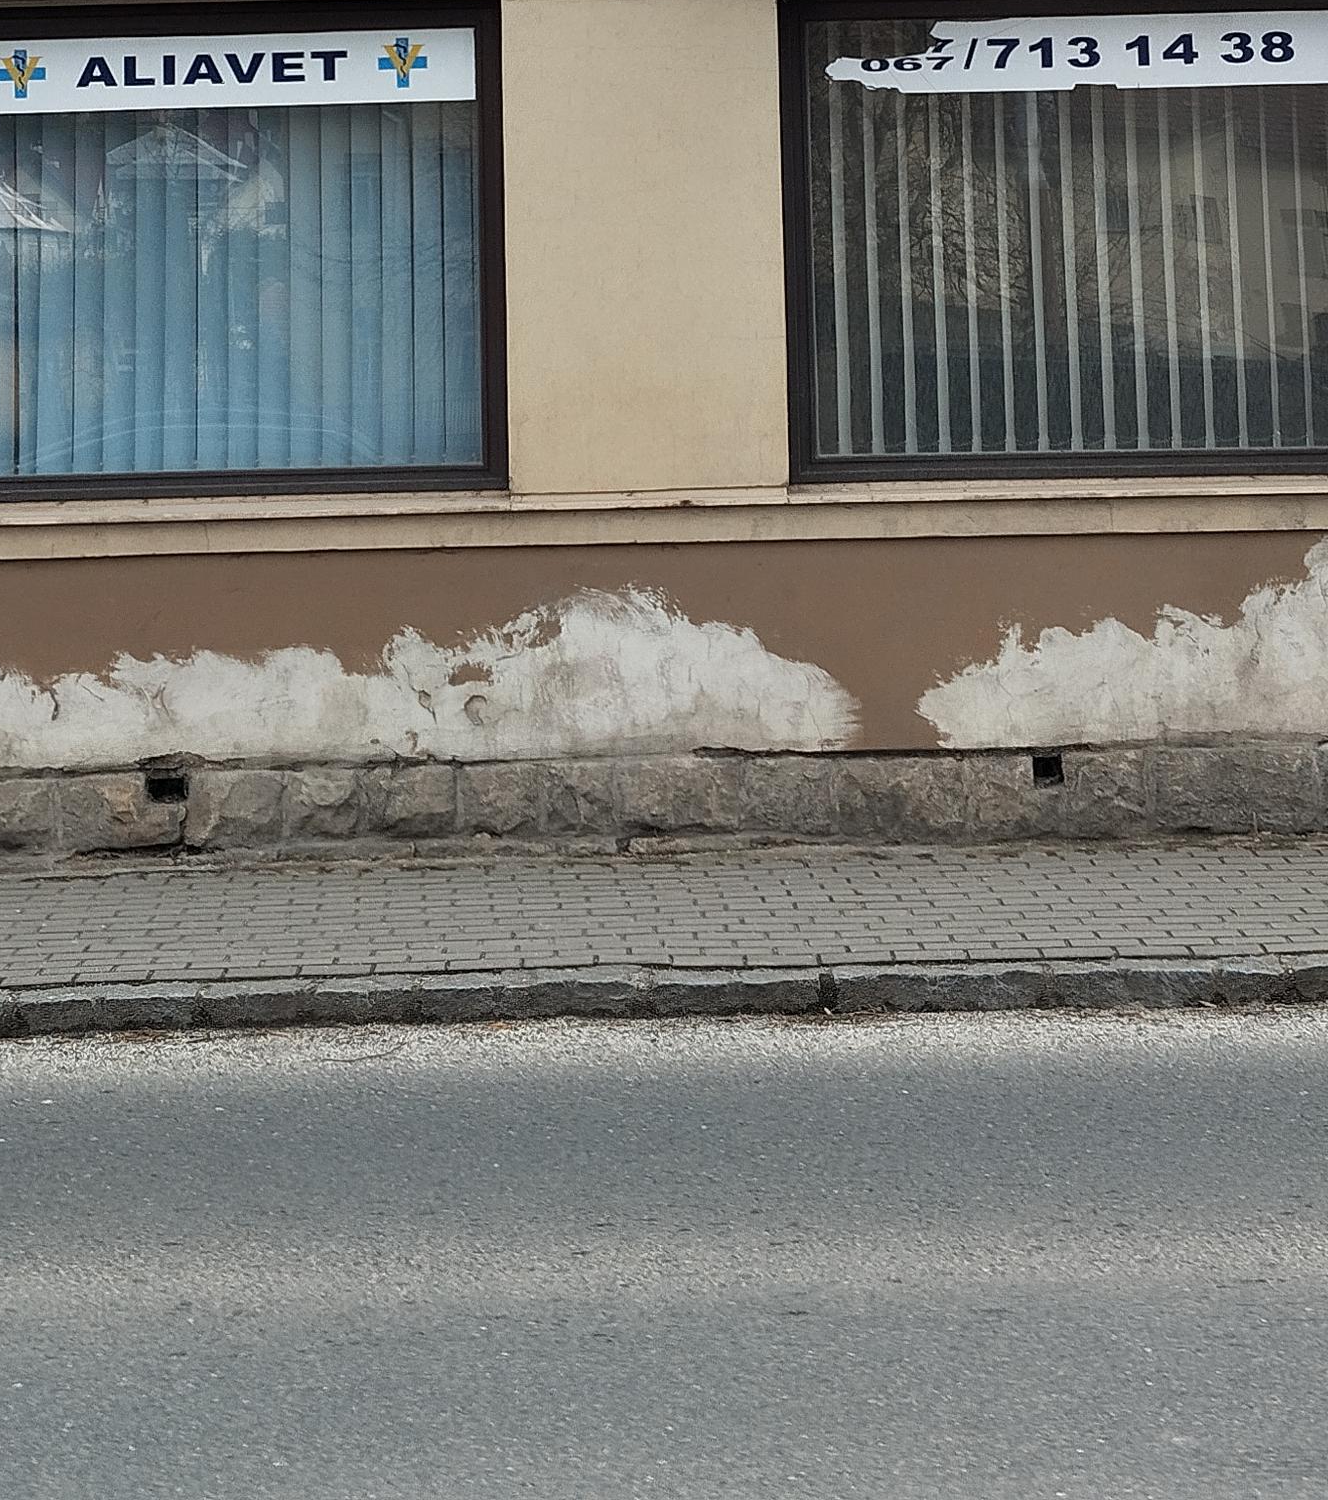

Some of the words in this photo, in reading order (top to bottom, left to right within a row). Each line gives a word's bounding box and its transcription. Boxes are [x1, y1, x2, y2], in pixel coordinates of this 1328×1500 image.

[1125, 33, 1199, 67] 14
[1219, 31, 1295, 64] 38
[76, 50, 348, 88] ALIAVET
